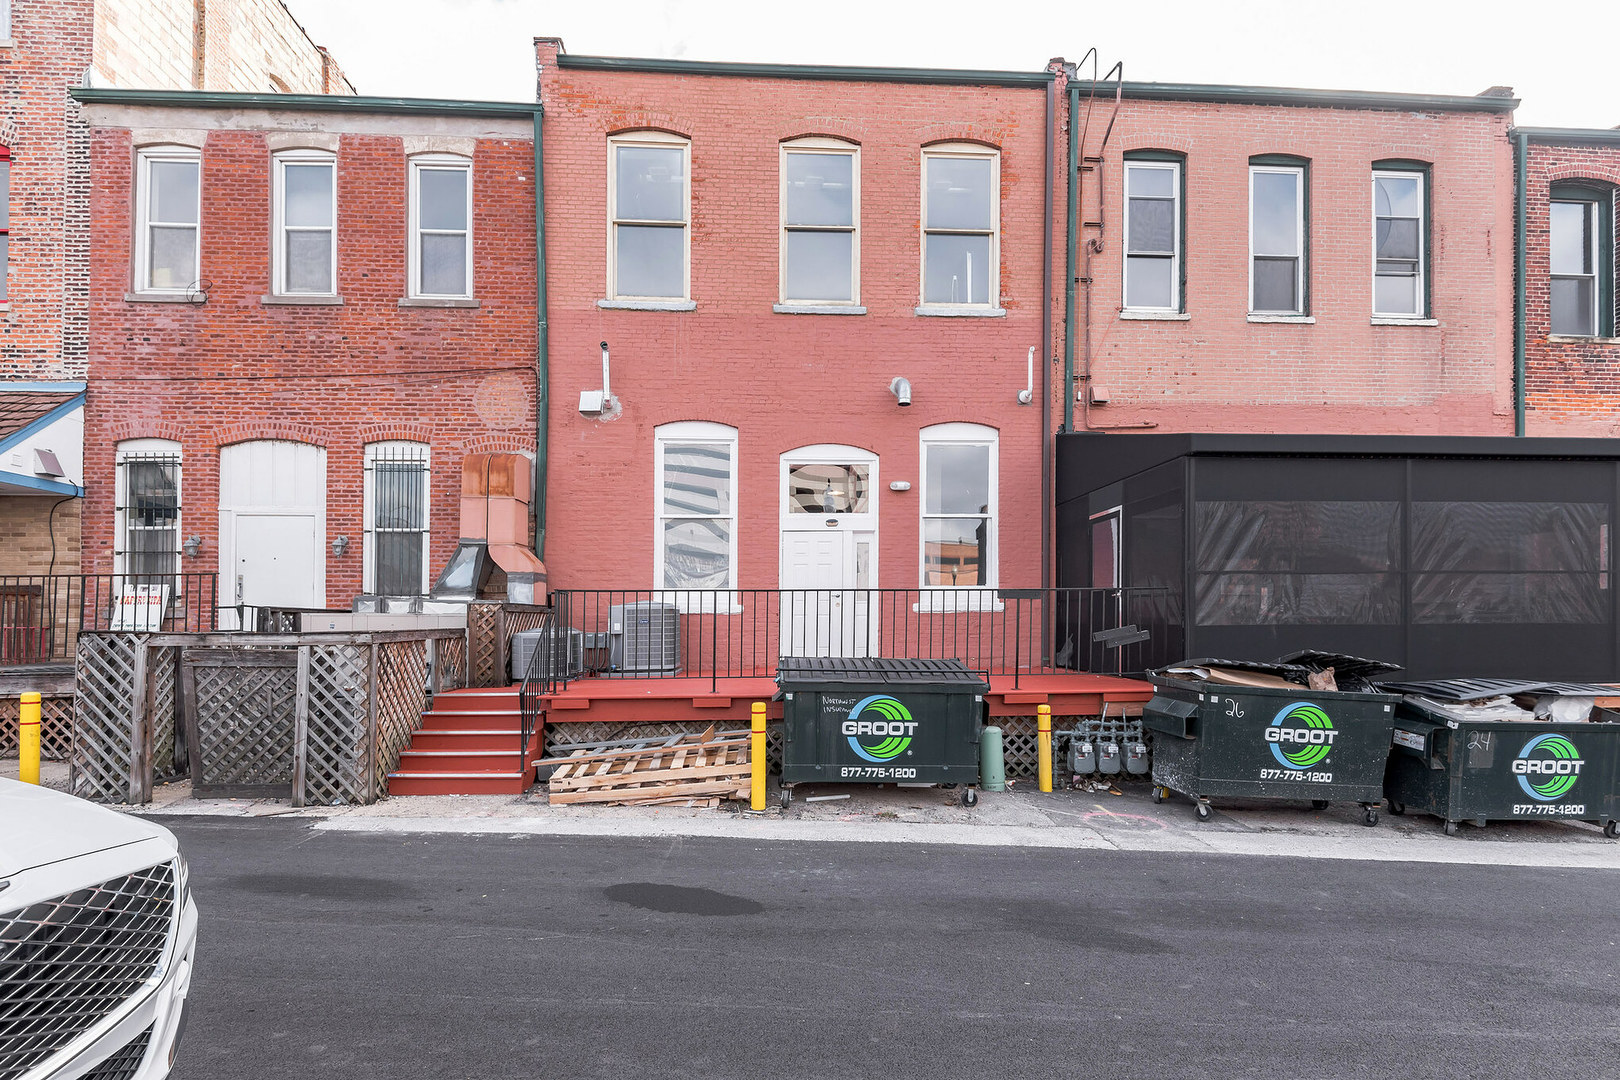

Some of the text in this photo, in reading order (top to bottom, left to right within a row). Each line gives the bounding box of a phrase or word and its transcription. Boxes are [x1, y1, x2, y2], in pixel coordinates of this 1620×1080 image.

[1224, 698, 1245, 718] 26
[841, 721, 919, 736] GROOT
[1264, 727, 1339, 745] GROOT
[1467, 730, 1492, 751] 24
[841, 767, 917, 779] 877-775-1200
[1512, 759, 1585, 774] GROOT
[1260, 768, 1333, 782] 877-775-1200
